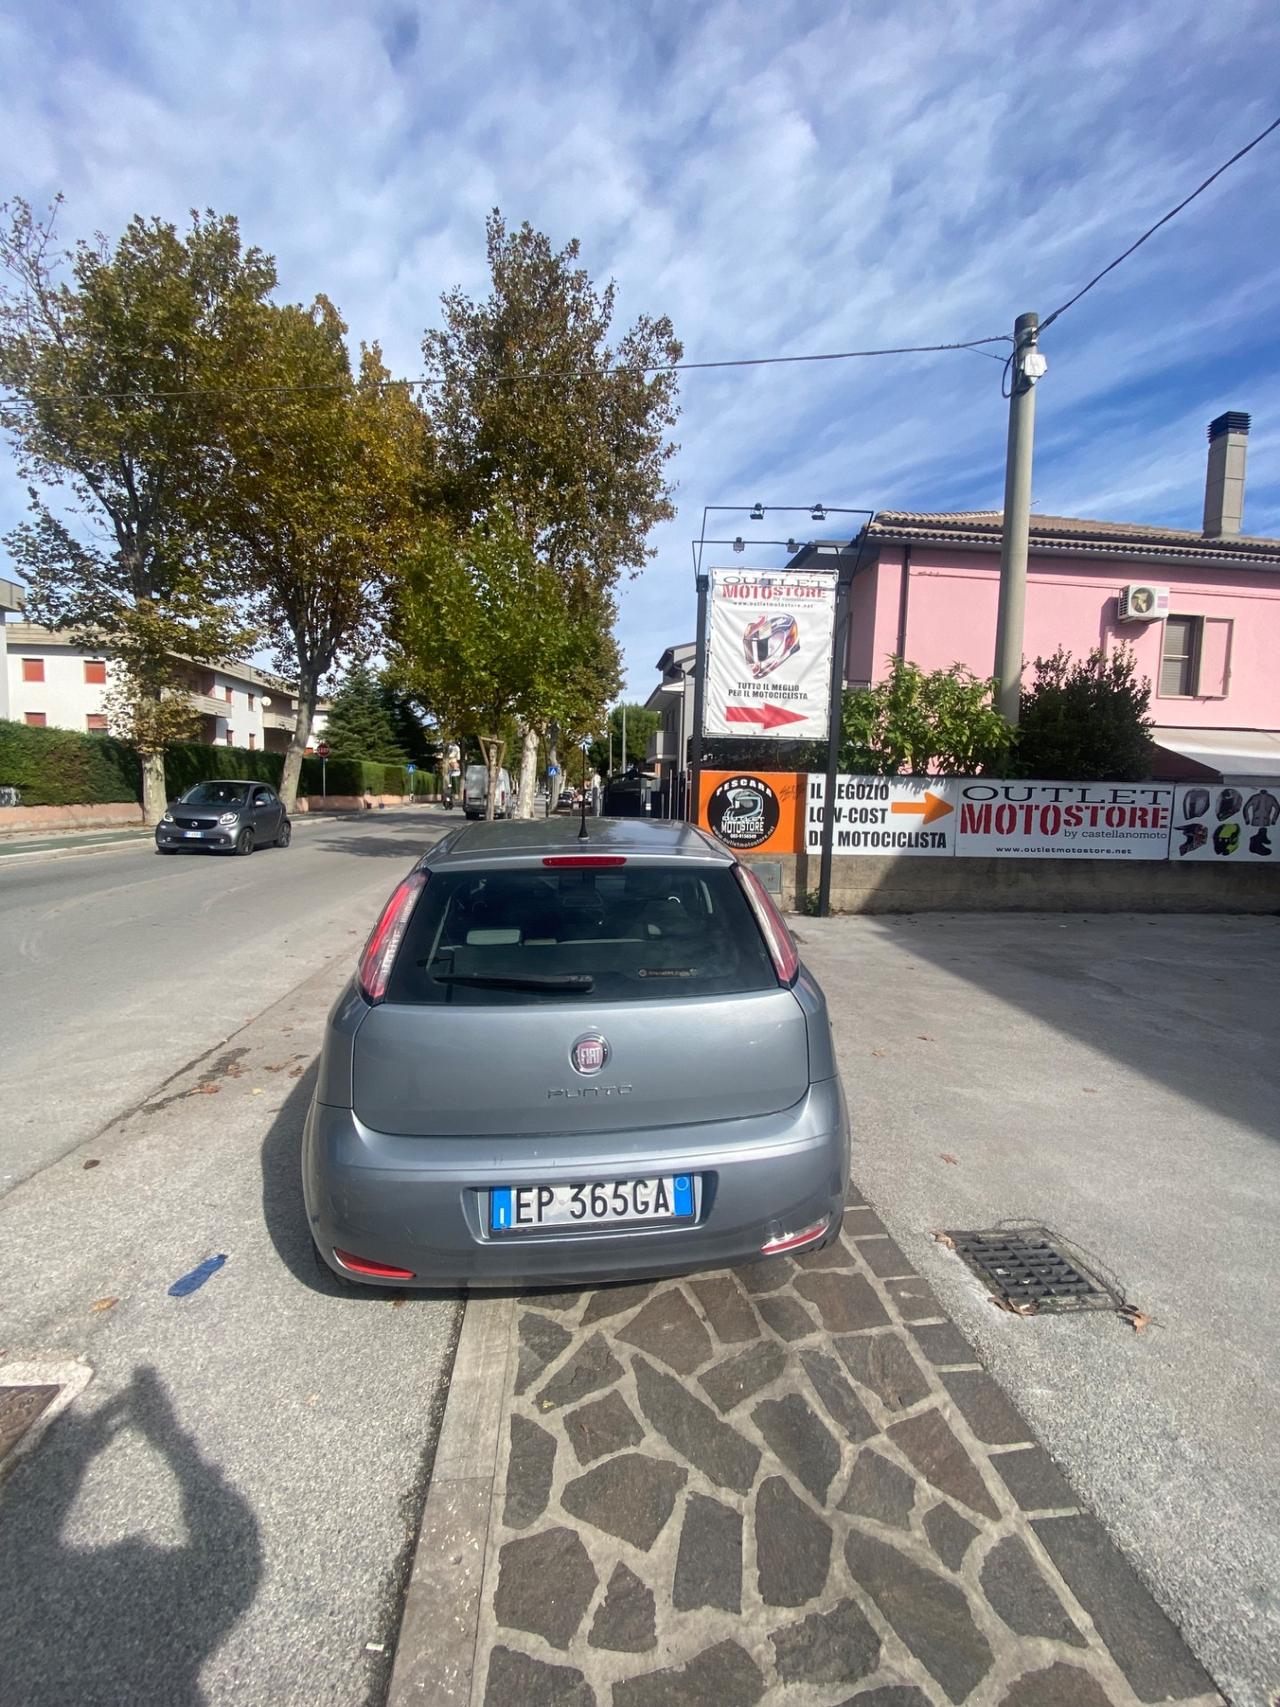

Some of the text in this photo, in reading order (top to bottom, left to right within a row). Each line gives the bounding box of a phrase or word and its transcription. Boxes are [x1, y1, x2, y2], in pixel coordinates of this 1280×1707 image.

[723, 576, 827, 588] OUTLET
[722, 584, 828, 600] MOTOSTORE
[728, 689, 808, 700] PER IL MOTOCICLISTA
[737, 682, 799, 692] TUTTO IL MEGLIO
[716, 778, 772, 798] PESCARA
[810, 783, 823, 799] IL
[836, 783, 890, 801] EGOZIO
[962, 785, 1171, 805] OUTLET
[721, 820, 764, 833] MOTOSTORE
[960, 803, 1169, 836] MOTOSTORE
[838, 830, 947, 849] MOTOCICLISTA
[1064, 829, 1168, 839] by castellanomoto
[996, 846, 1132, 854] www.outletmotostore.net
[580, 1046, 601, 1065] FIAT
[547, 1083, 633, 1099] PUNTO
[515, 1177, 670, 1224] EP 365GA
